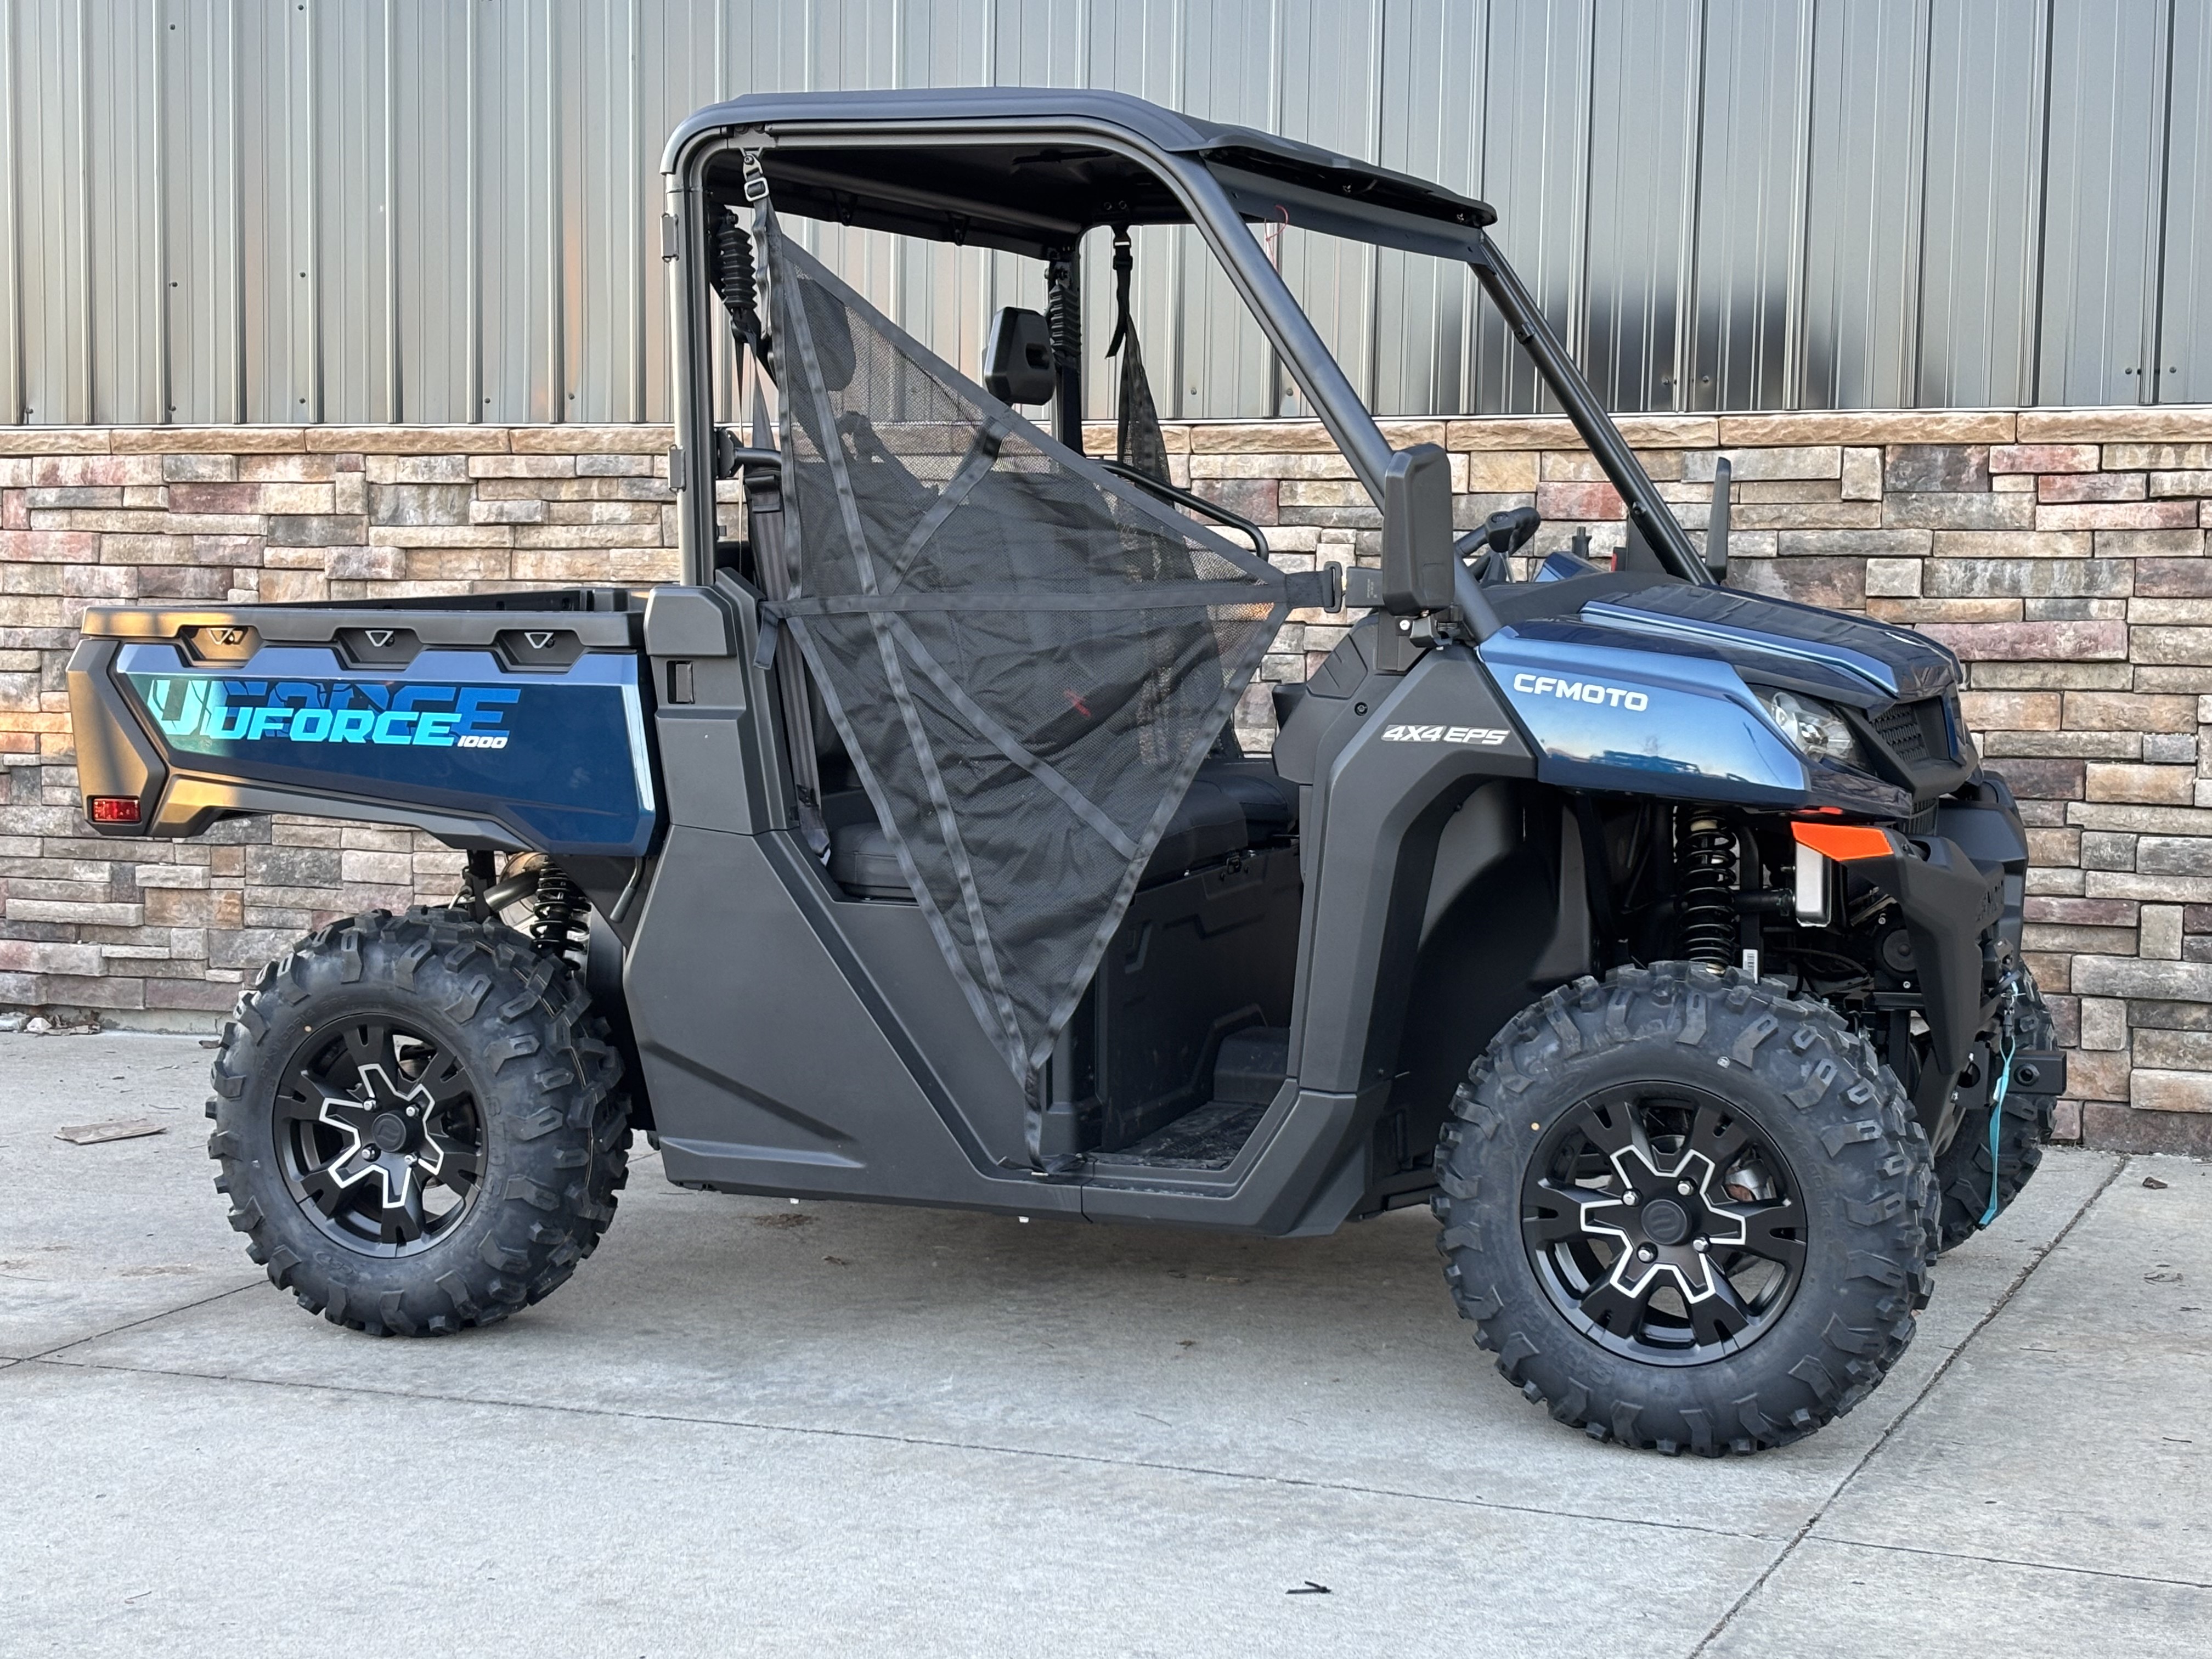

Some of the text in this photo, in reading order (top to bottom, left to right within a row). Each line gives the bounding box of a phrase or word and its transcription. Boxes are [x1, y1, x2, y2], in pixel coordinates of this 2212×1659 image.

[1514, 673, 1648, 712] CFMOTO
[210, 706, 508, 748] UFORCE 1000
[1383, 725, 1510, 744] 4X4 EPS
